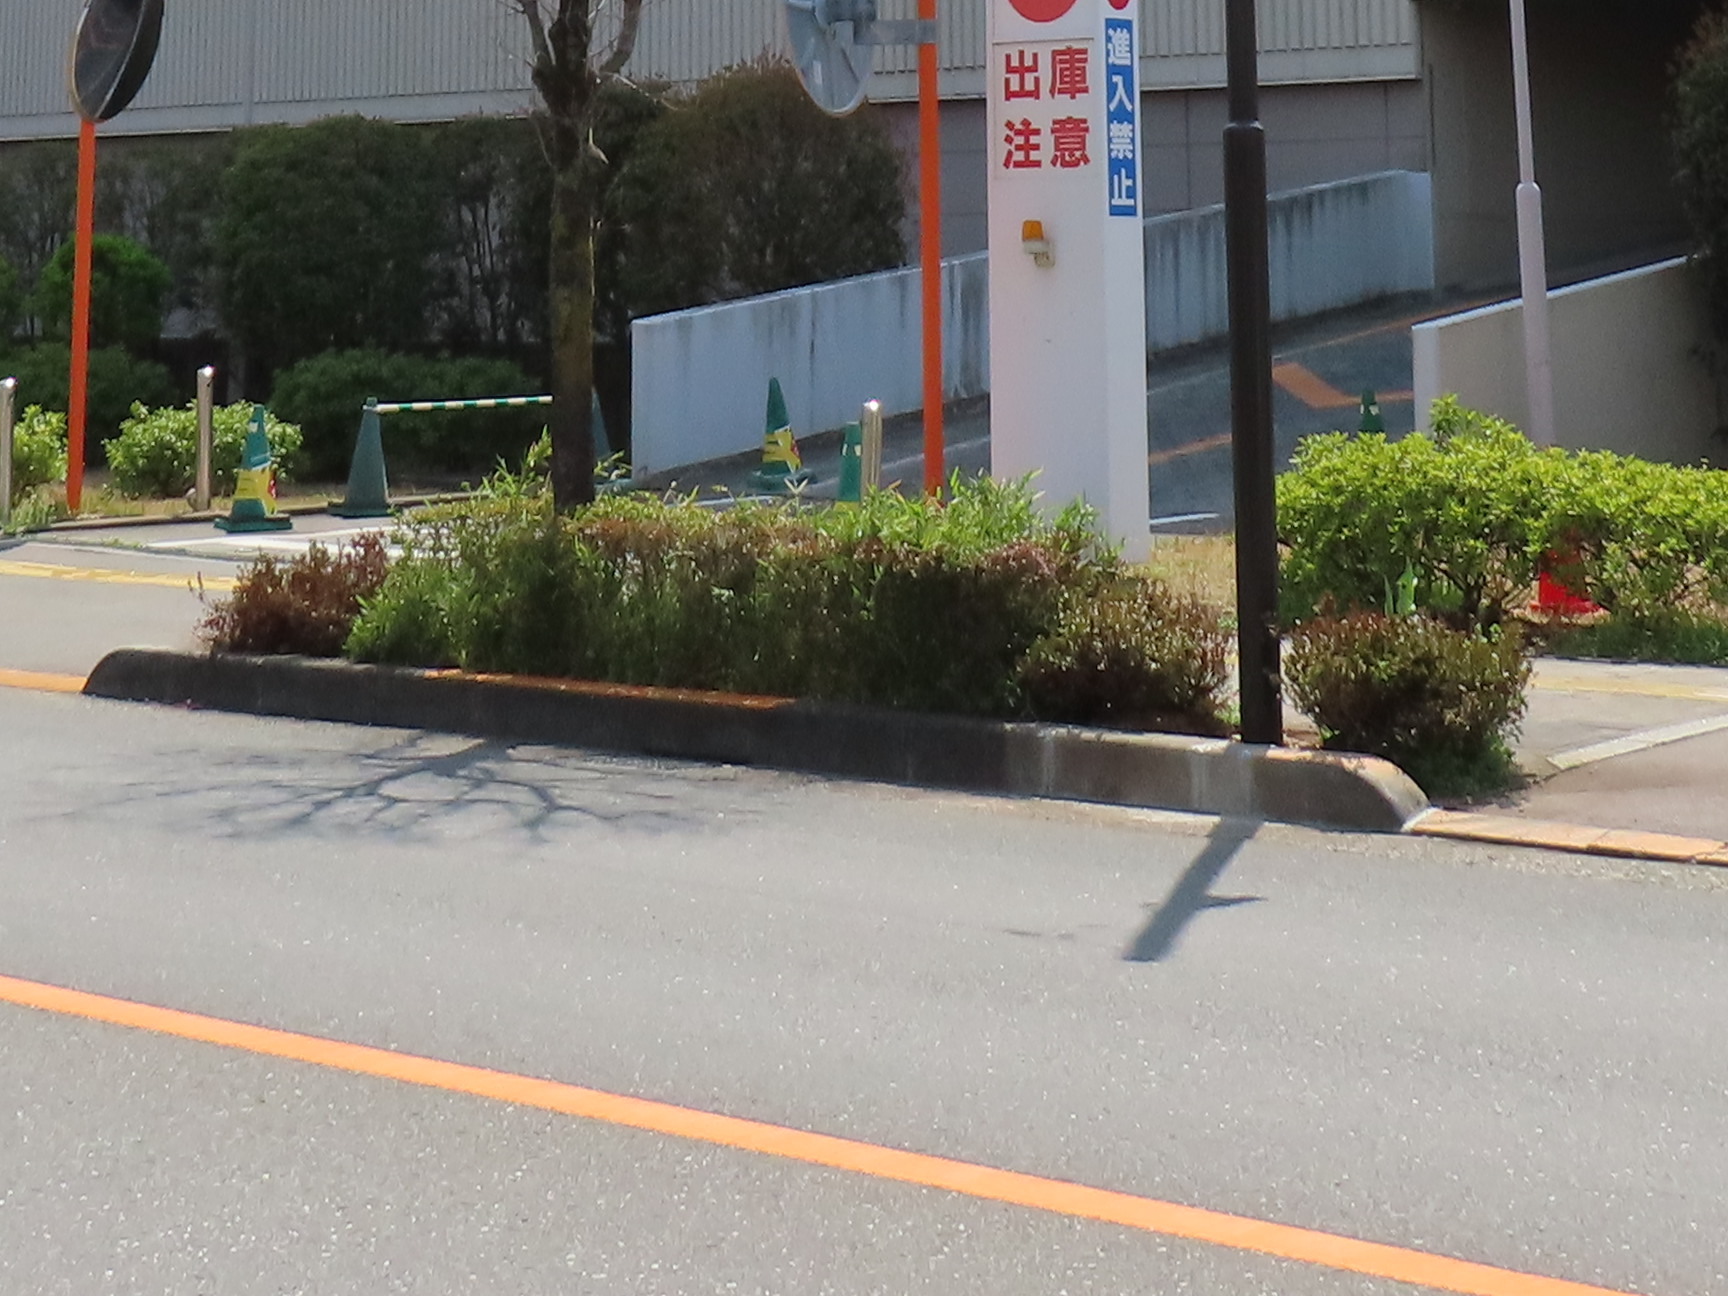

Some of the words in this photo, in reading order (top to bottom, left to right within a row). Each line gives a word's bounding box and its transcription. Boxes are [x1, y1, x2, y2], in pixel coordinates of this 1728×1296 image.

[1003, 45, 1090, 102] 出庫
[1002, 115, 1091, 169] 注意
[1106, 27, 1136, 206] 進入禁止
